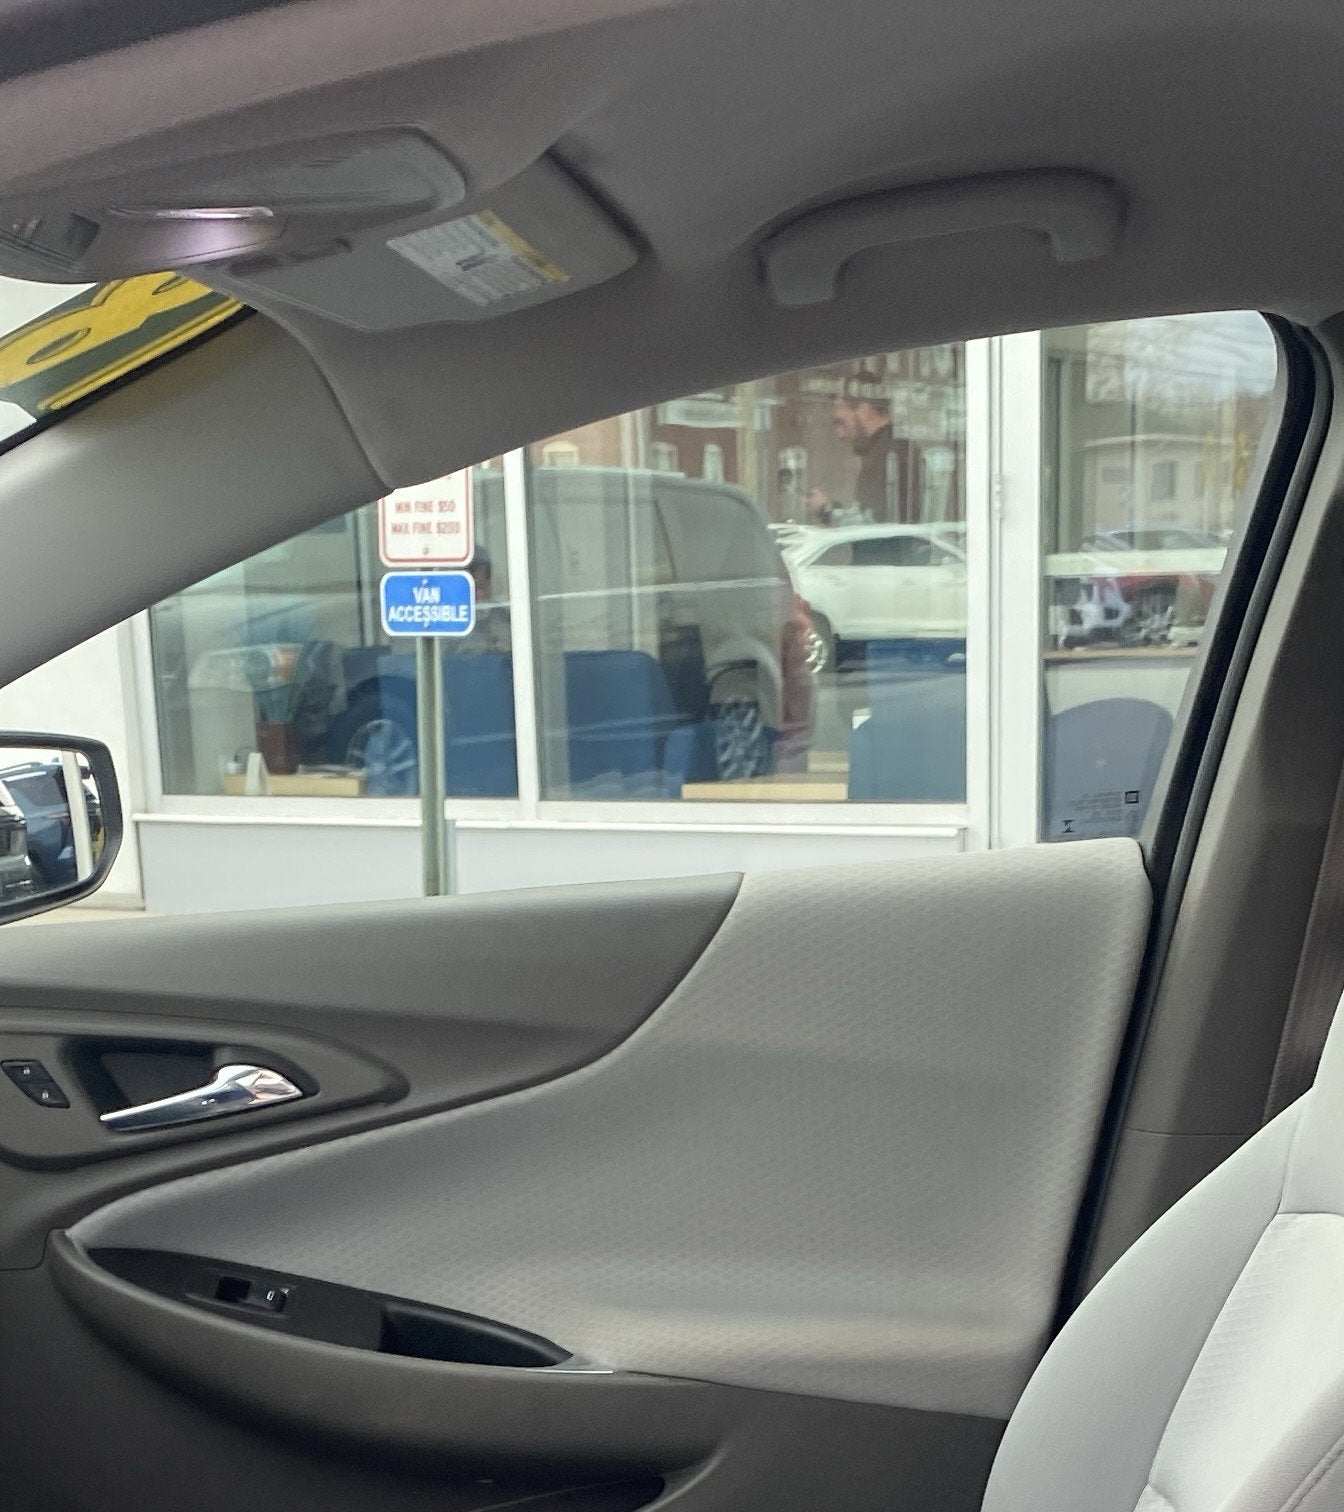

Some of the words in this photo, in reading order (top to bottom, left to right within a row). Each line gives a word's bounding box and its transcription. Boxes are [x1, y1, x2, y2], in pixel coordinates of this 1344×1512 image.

[415, 500, 433, 513] FINE
[413, 521, 432, 534] FINE
[412, 586, 441, 603] VAN
[387, 605, 469, 623] ACCESSIBLE
